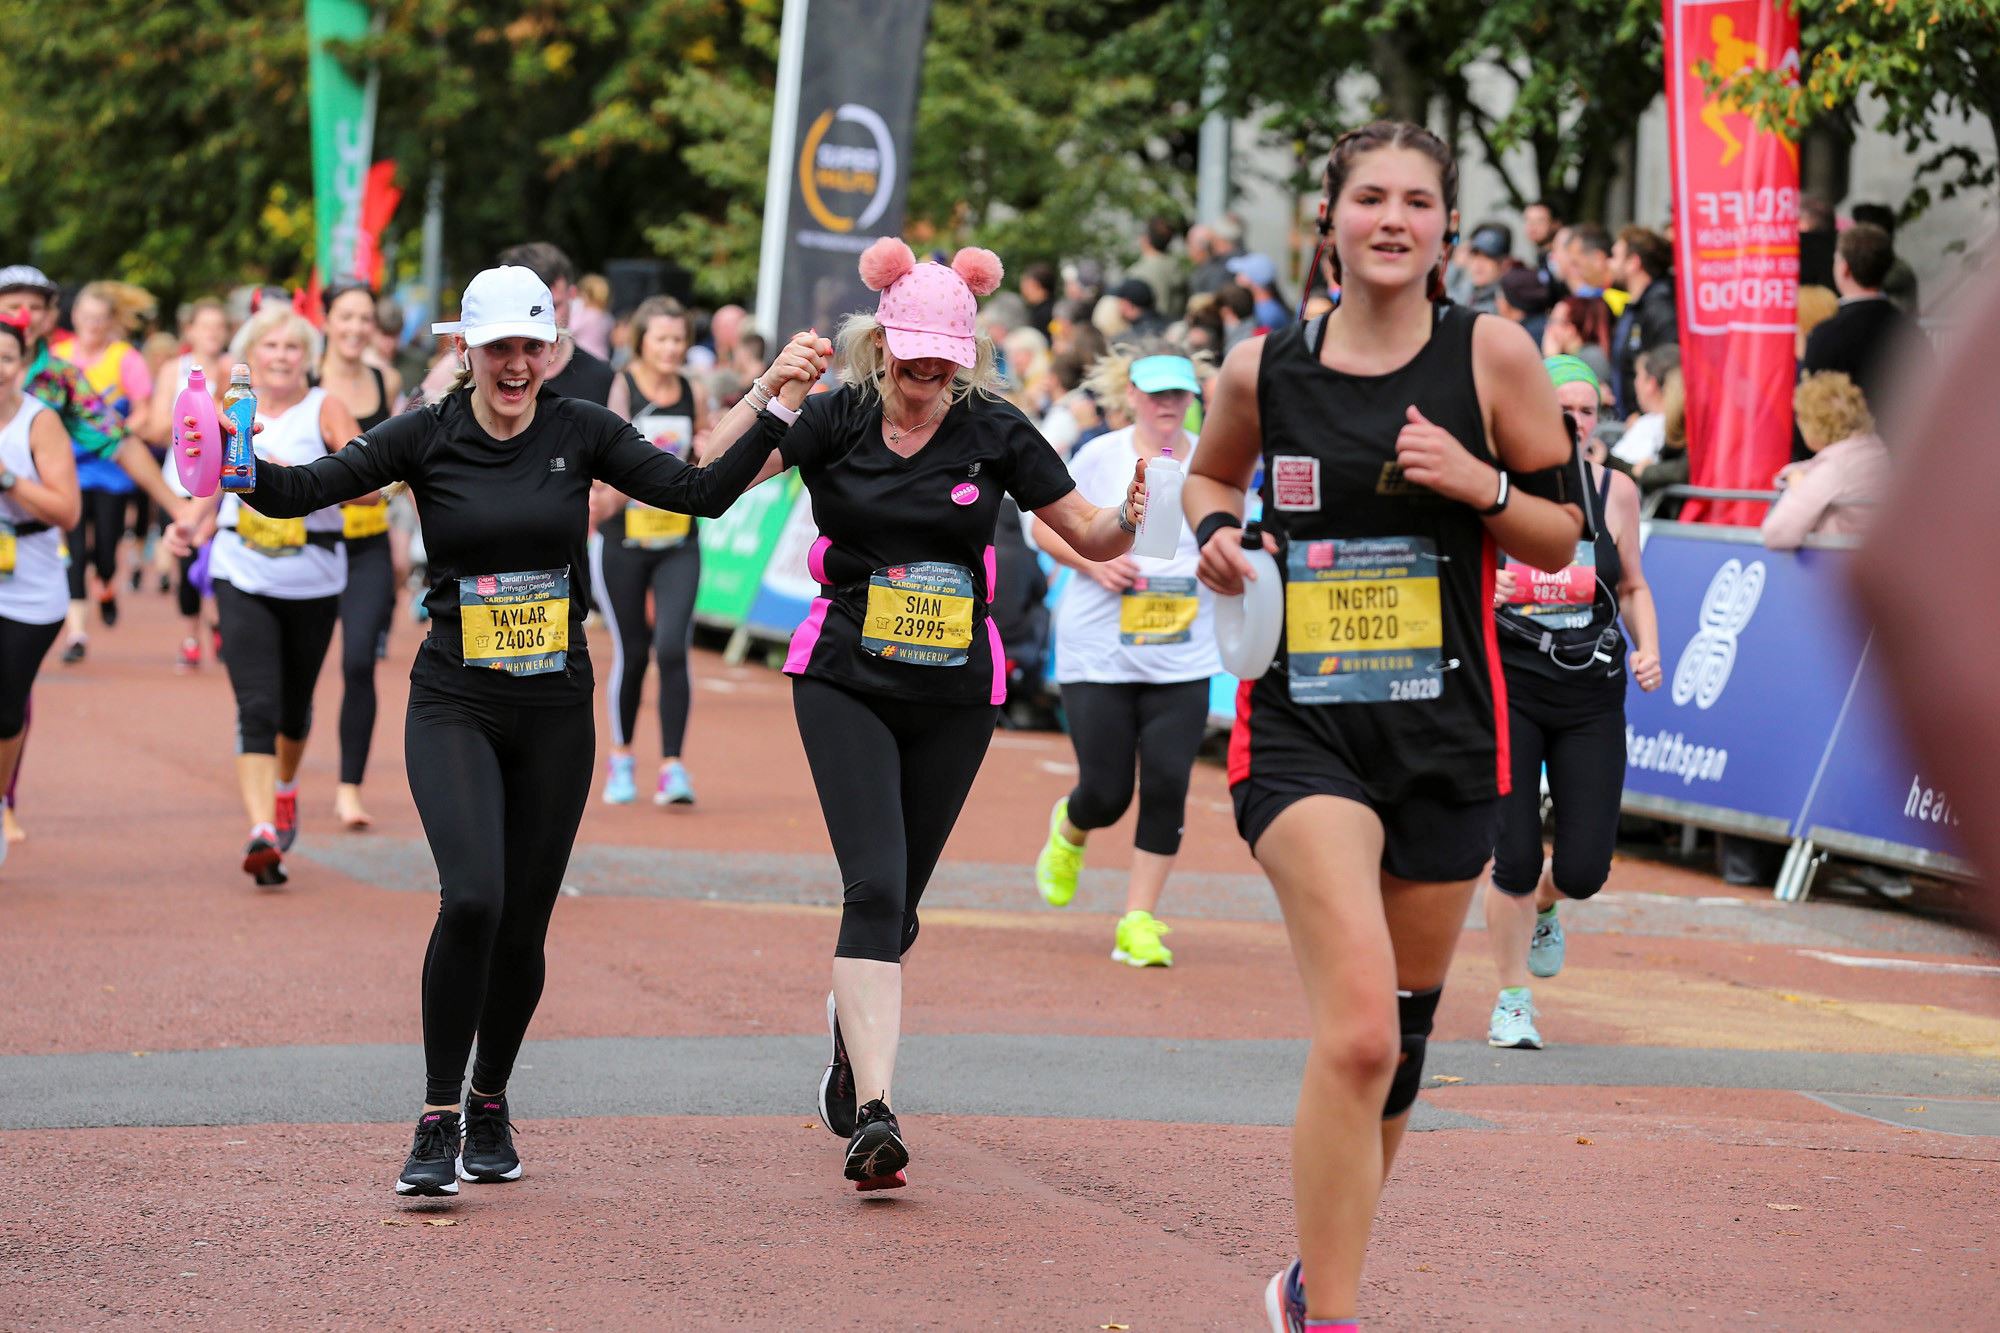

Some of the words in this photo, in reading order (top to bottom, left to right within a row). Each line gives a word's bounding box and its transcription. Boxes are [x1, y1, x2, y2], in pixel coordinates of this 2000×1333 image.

[500, 575, 522, 583] Cardiff
[501, 584, 528, 593] Prifysgol
[529, 581, 555, 591] Caerdydd
[892, 580, 921, 590] CARDIFF
[923, 584, 942, 592] HALF
[515, 594, 533, 602] HALF
[535, 592, 550, 600] 2019
[905, 596, 942, 616] SIAN
[1328, 586, 1399, 610] INGRID
[491, 606, 547, 626] TAYLAR
[894, 616, 945, 640] 23995
[1329, 615, 1399, 641] 26020
[495, 628, 545, 650] 24036
[1390, 679, 1439, 700] 26020
